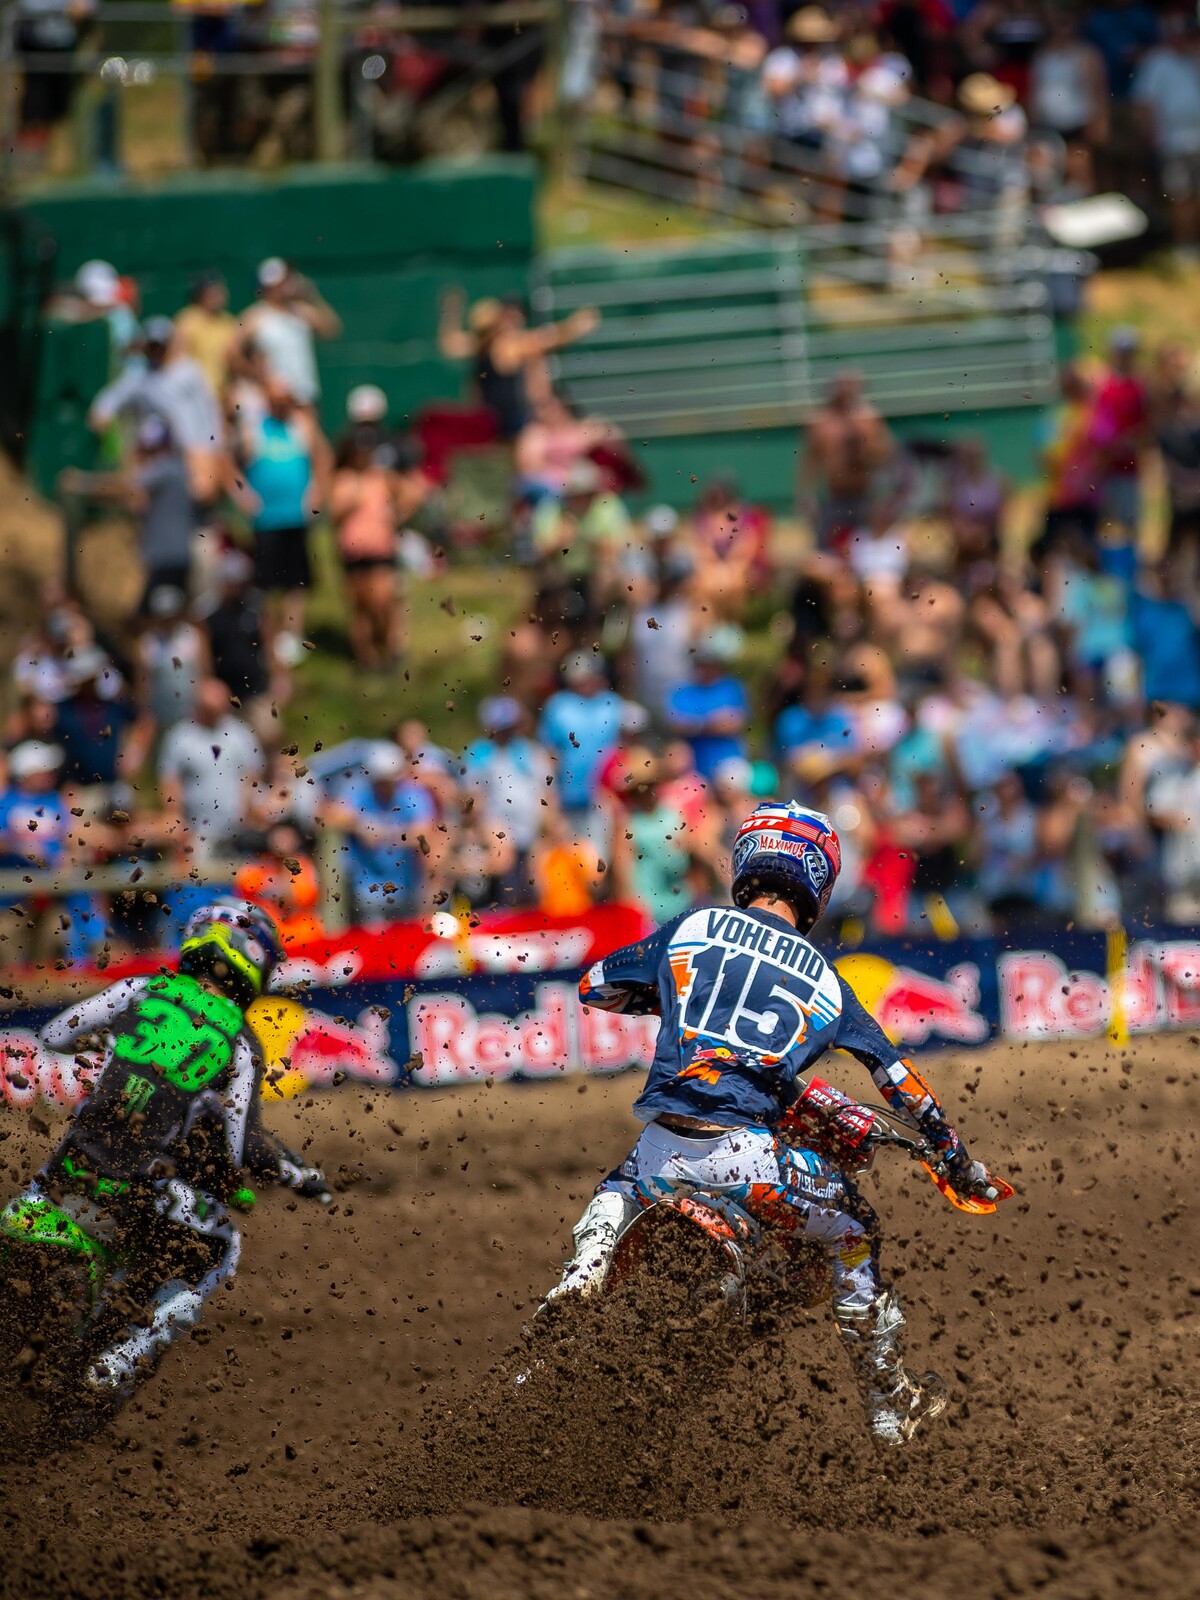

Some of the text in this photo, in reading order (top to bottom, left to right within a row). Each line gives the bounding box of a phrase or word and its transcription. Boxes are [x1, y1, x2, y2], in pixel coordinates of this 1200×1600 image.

[760, 834, 807, 859] MAXIMUS
[706, 910, 825, 983] VOHLAND
[684, 945, 816, 1055] 115
